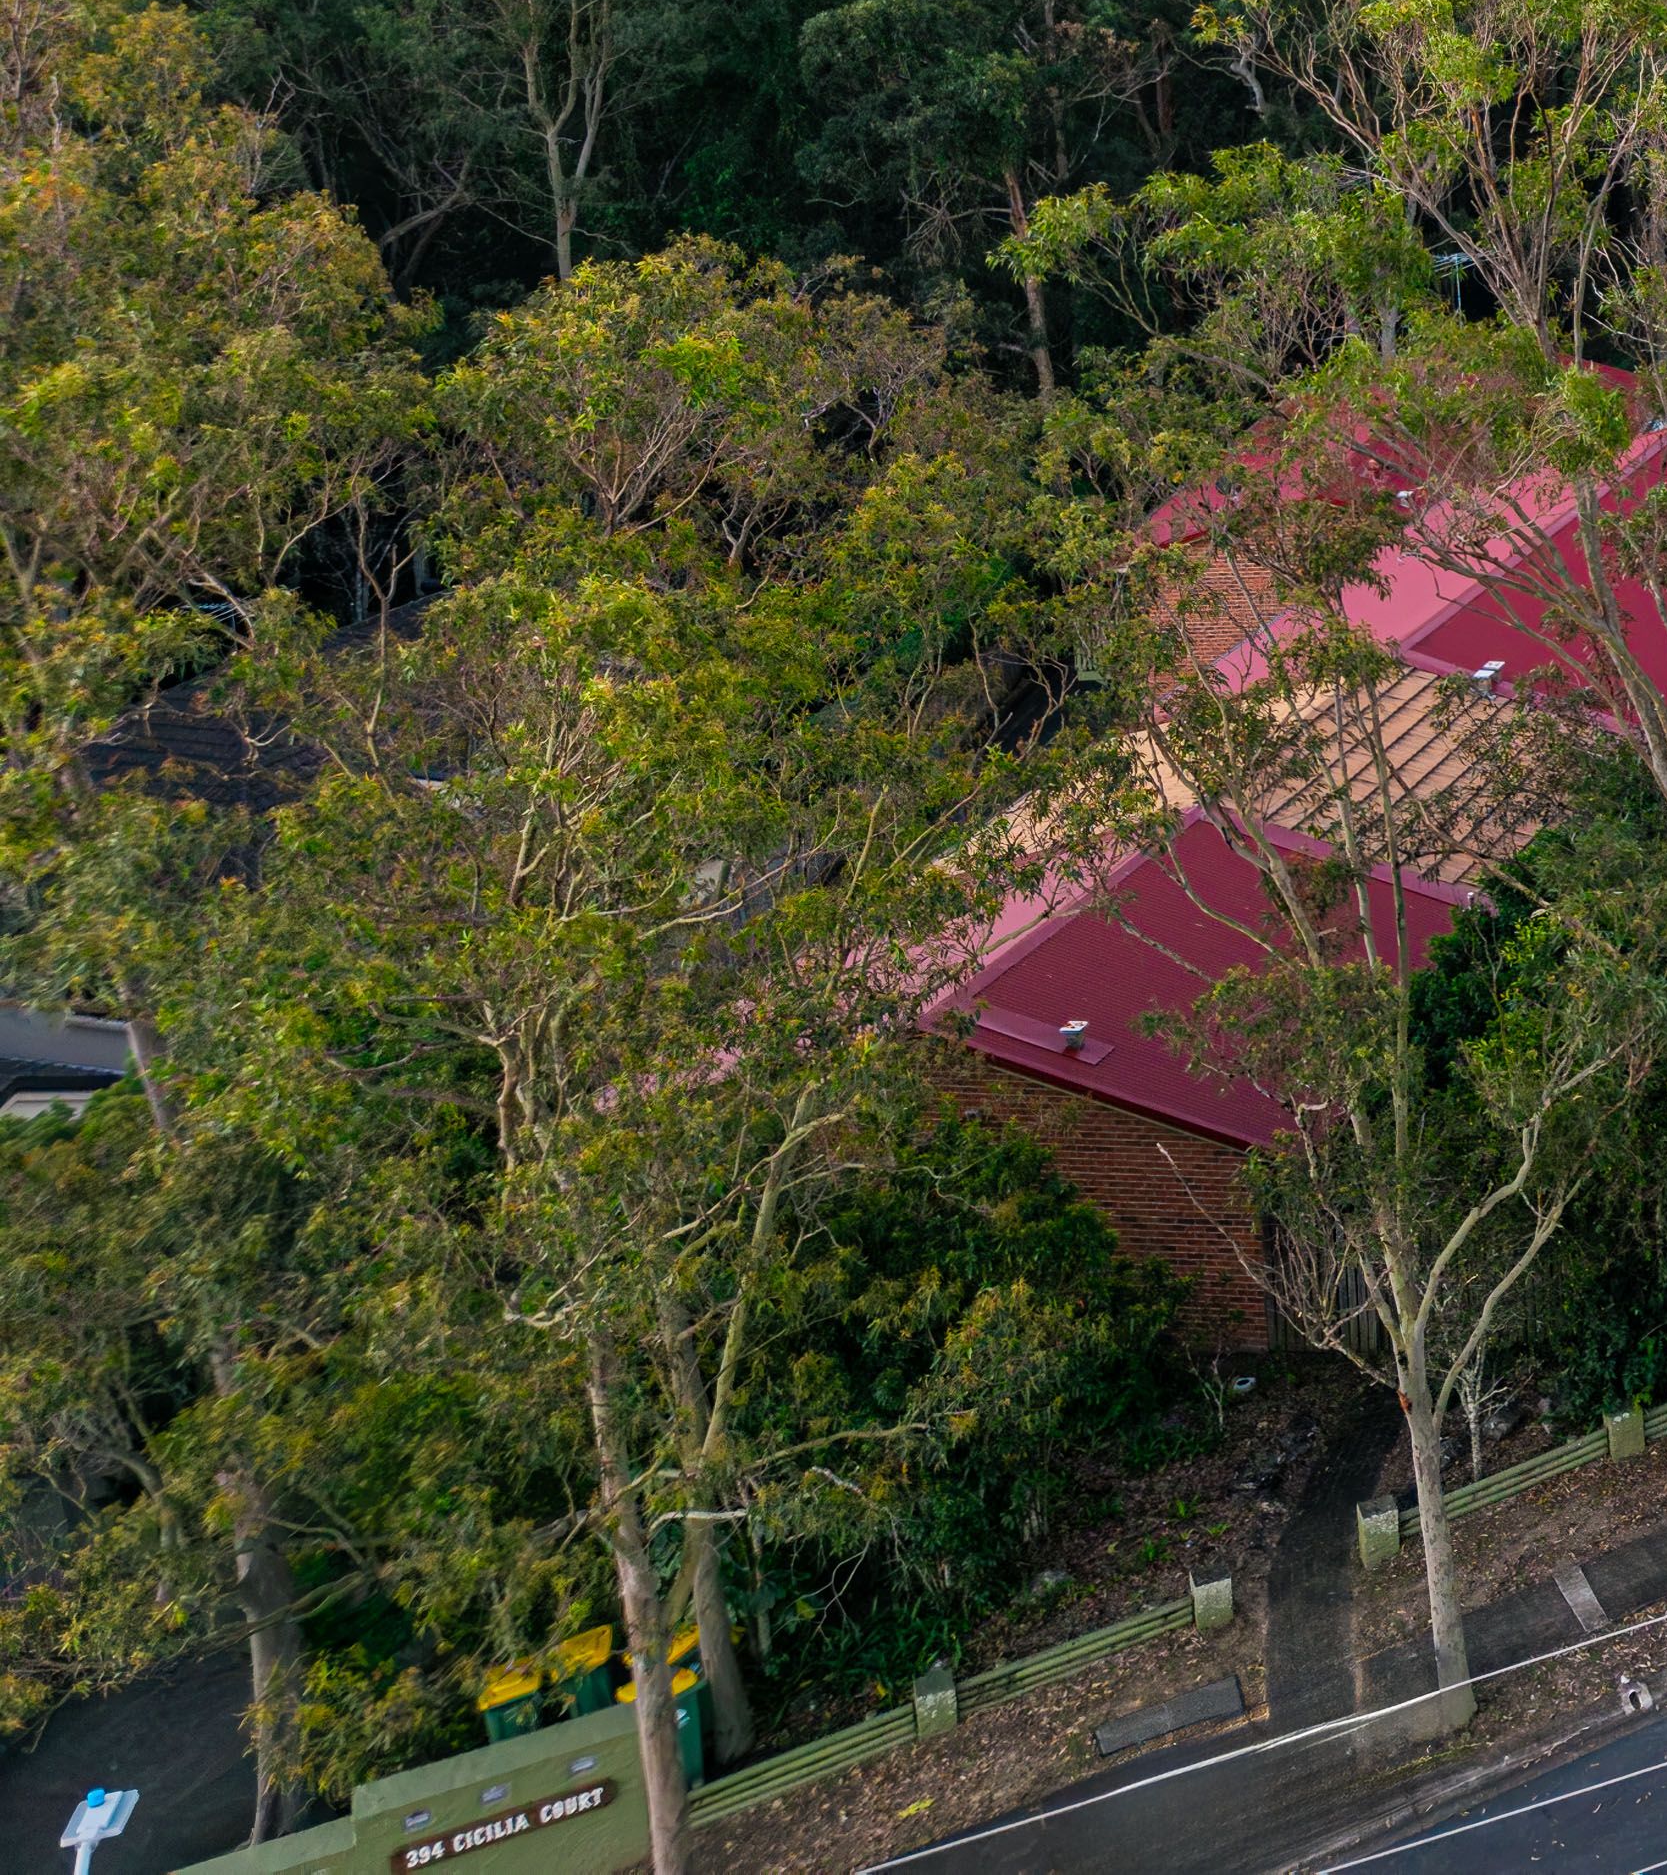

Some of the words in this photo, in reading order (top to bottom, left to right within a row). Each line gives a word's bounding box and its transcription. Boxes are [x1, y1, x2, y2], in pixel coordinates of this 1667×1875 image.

[406, 1839, 445, 1869] 394
[452, 1812, 531, 1853] CICILIA
[540, 1786, 605, 1824] COURT
